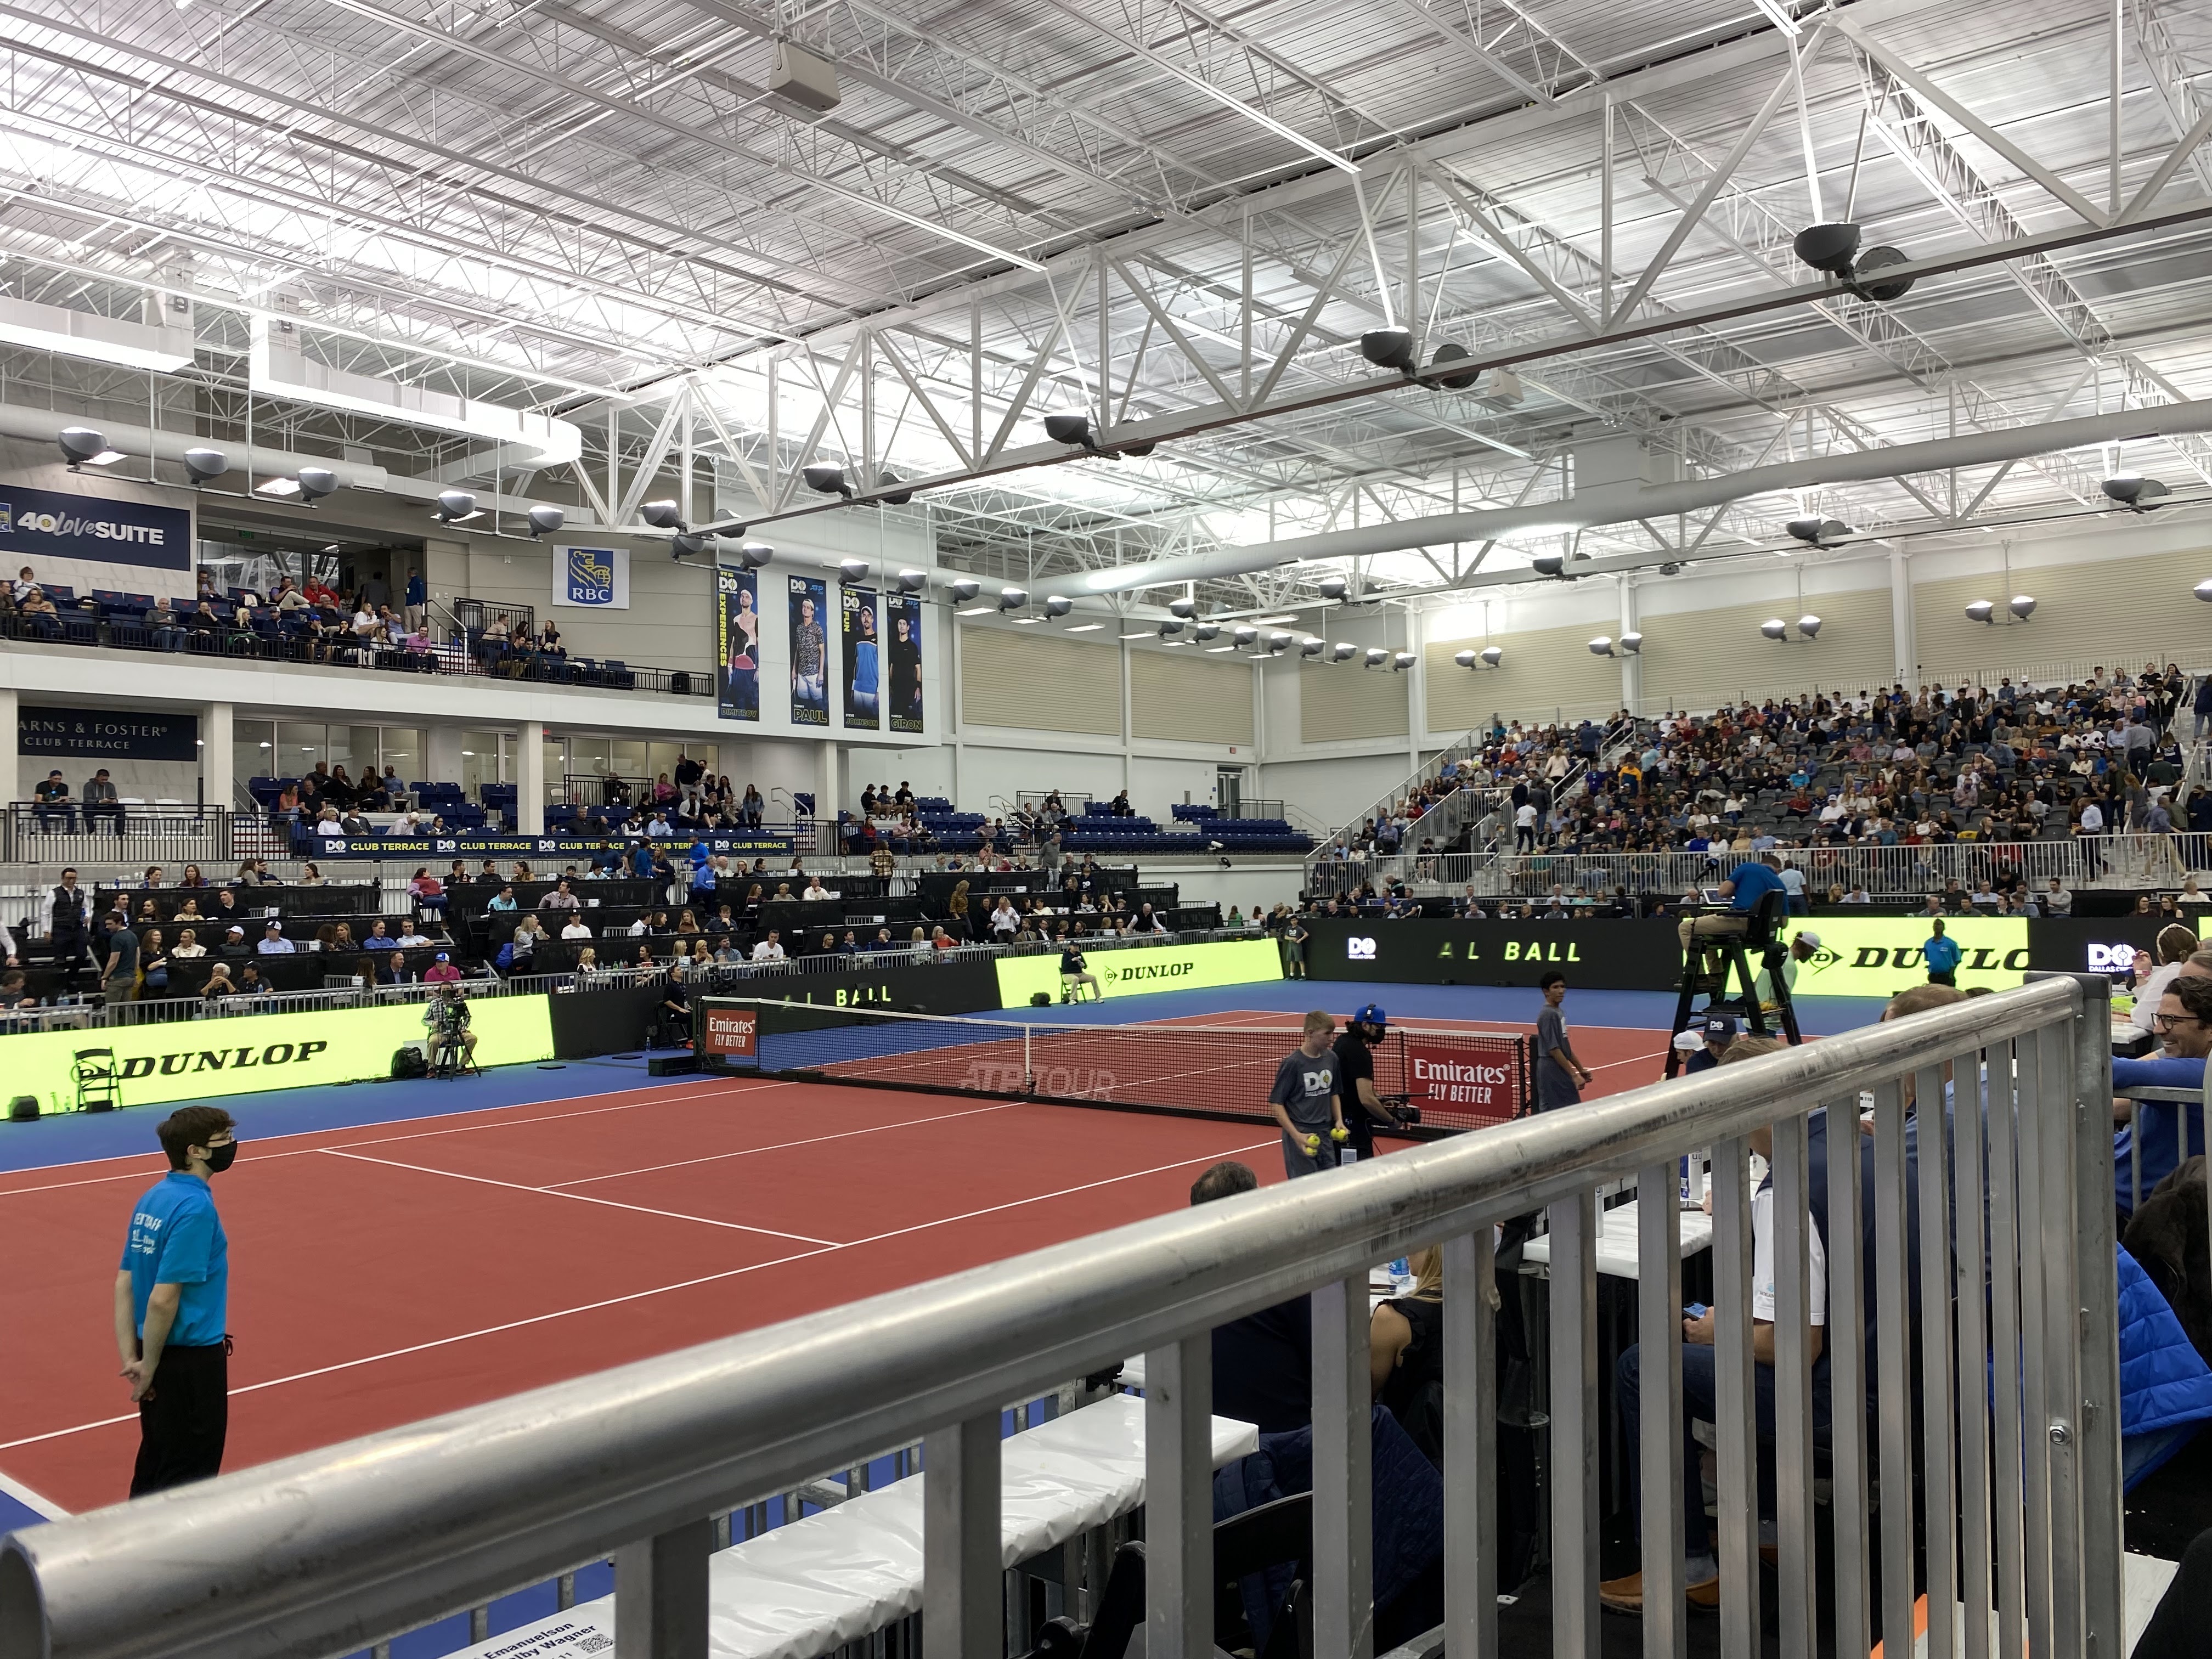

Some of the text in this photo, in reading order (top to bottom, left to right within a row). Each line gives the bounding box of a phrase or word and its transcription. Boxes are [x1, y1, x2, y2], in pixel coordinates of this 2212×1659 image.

[719, 577, 737, 591] DO
[791, 579, 806, 591] DO
[572, 588, 609, 601] RBC
[843, 595, 860, 608] DO
[719, 593, 727, 667] EXPERIENCES
[721, 708, 757, 718] DIMITROV
[794, 709, 827, 723] PAUL
[75, 723, 84, 733] &
[845, 718, 878, 727] JOHNSON
[891, 719, 922, 730] GIRON
[24, 737, 131, 749] CLUB TERRACE
[325, 840, 346, 850] DO
[381, 843, 429, 851] TERRACE
[437, 840, 456, 850] DO
[539, 840, 556, 850] DO
[715, 840, 730, 849] DO
[1348, 937, 1376, 955] DO
[1504, 941, 1581, 962] BALL
[1849, 947, 2030, 970] DULO
[2087, 944, 2136, 966] DO
[1121, 962, 1194, 981] DUNLOP
[715, 1034, 746, 1048] FLY BETTER
[118, 1041, 328, 1080] DUNLOP
[1029, 1065, 1116, 1102] TOUR
[1304, 1069, 1333, 1092] DO
[1428, 1083, 1492, 1104] FLY BETTER
[483, 1622, 575, 1659] Emanuelson
[539, 1624, 597, 1649] Wagner
